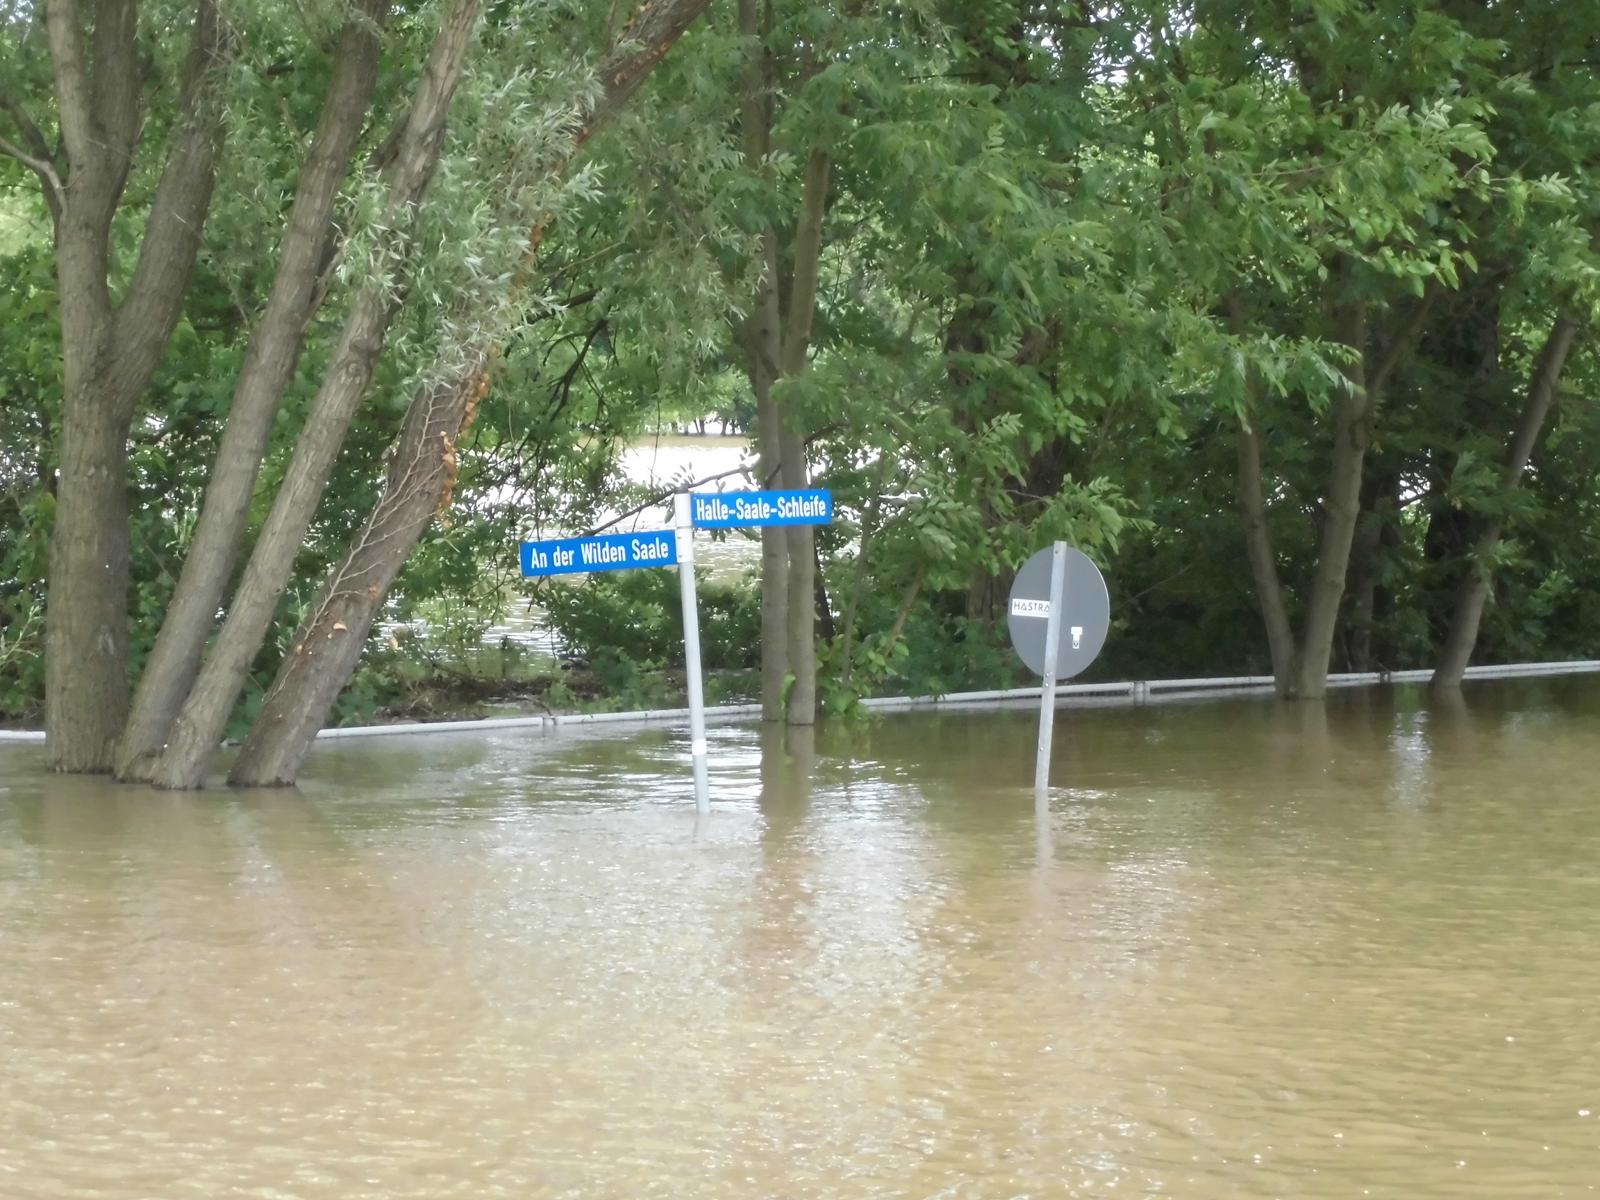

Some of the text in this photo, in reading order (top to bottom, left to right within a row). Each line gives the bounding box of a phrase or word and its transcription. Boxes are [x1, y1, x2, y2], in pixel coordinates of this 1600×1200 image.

[696, 495, 826, 520] Halle-Saale-Schleife
[531, 537, 669, 569] An der Wilden Saale
